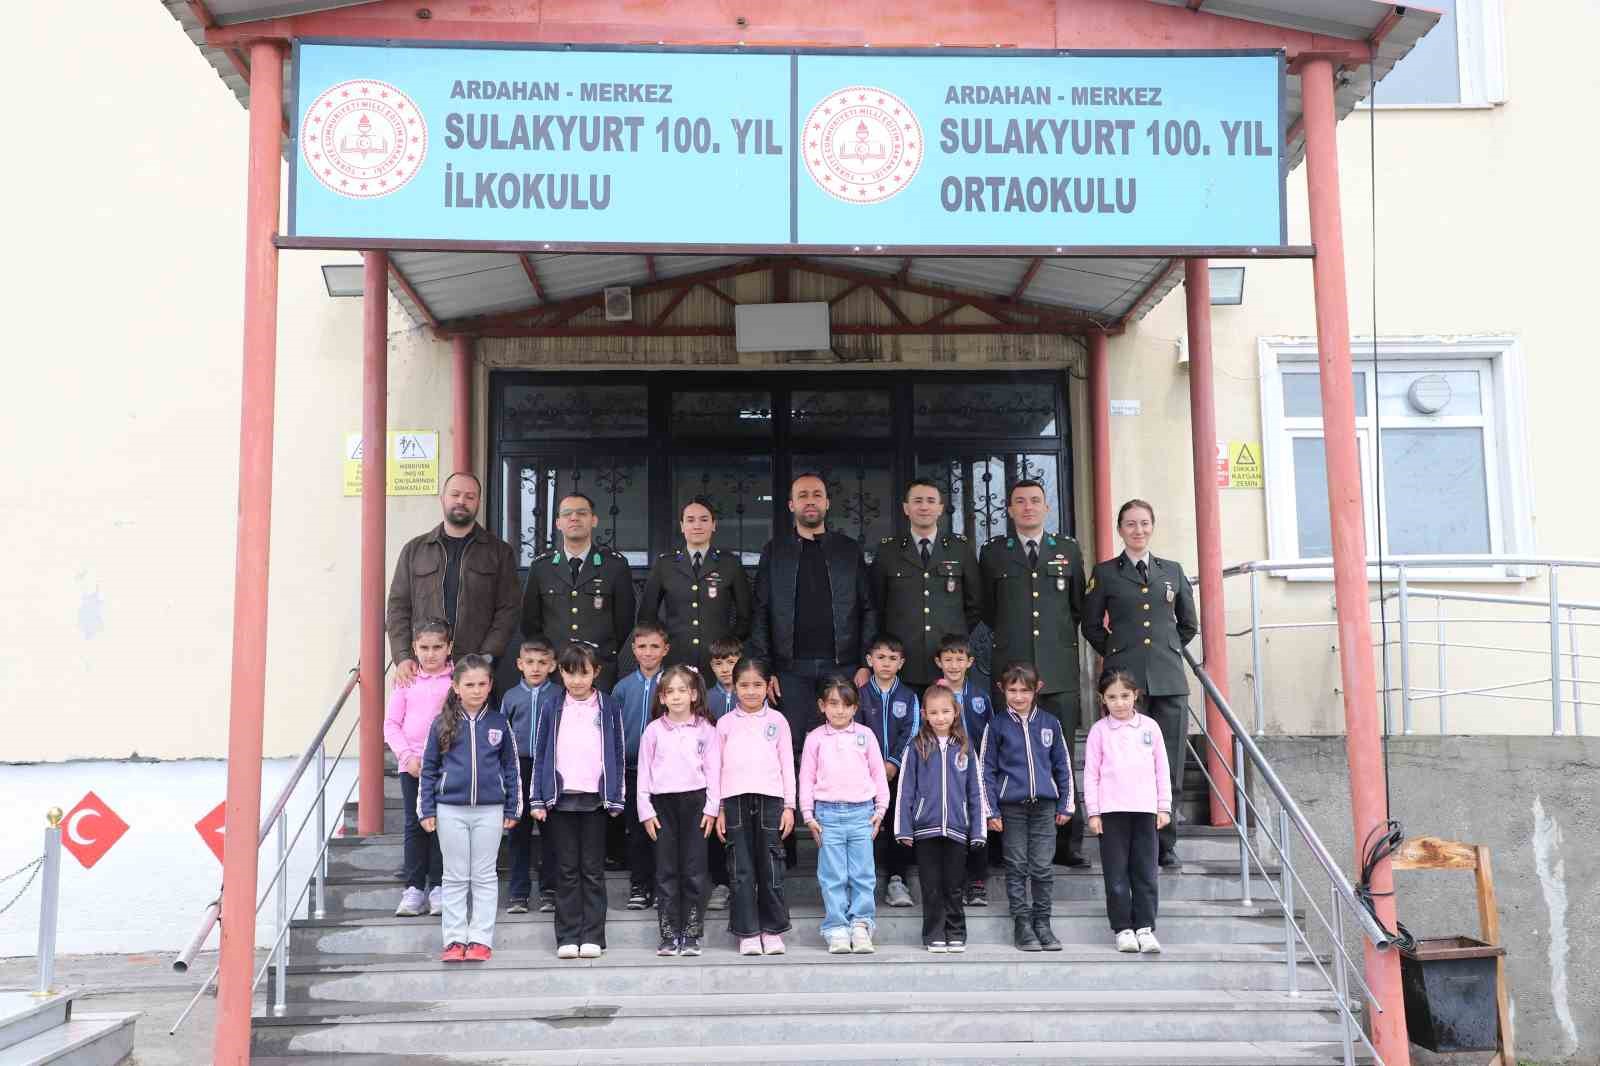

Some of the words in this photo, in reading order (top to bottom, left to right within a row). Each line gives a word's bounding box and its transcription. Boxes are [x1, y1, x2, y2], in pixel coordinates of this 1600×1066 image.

[450, 79, 560, 101] ARDAHAN
[580, 82, 673, 103] MERKEZ
[944, 85, 1051, 105] ARDAHAN
[1071, 86, 1163, 106] MERKEZ
[444, 112, 645, 153] SULAKYURT
[655, 116, 721, 154] 100.
[731, 118, 783, 155] YIL
[939, 117, 1136, 156] SULAKYURT
[1146, 119, 1212, 156] 100.
[1220, 120, 1273, 157] YIL
[444, 162, 611, 210] İLKOKULU
[940, 175, 1137, 214] ORTAOKULU
